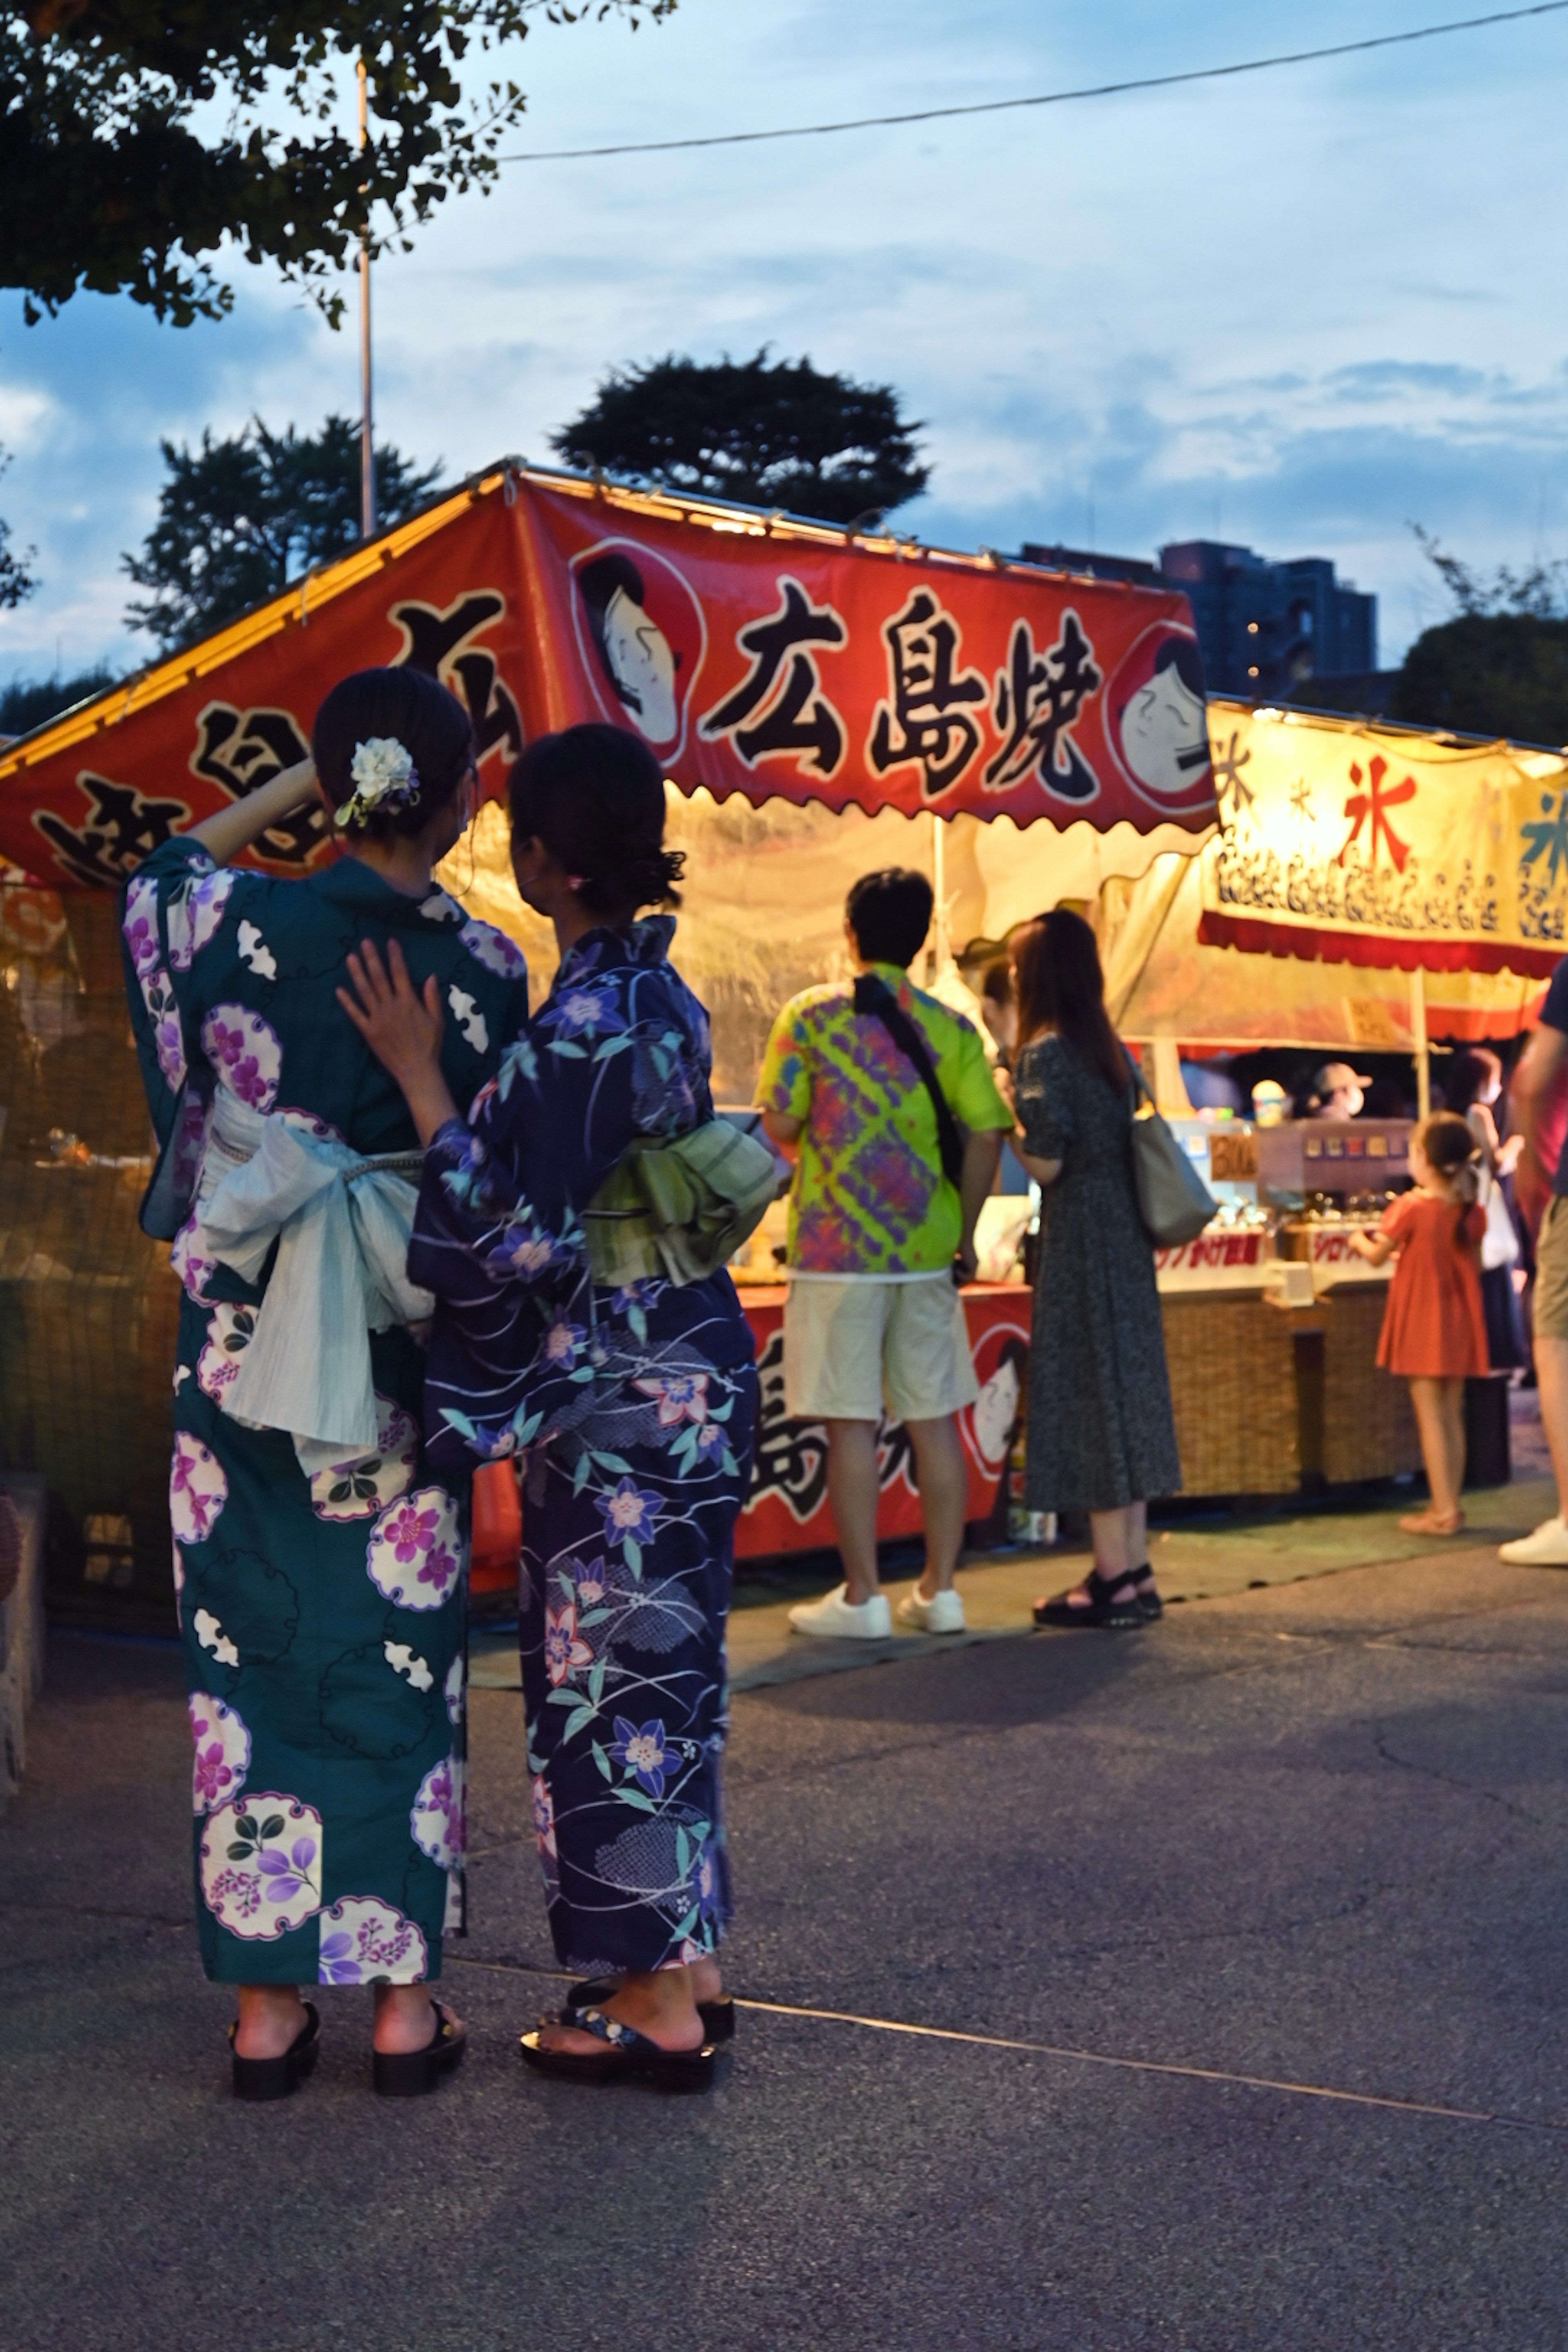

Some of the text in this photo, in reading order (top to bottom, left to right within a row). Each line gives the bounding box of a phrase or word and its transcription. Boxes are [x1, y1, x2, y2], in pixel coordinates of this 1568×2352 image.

[698, 574, 1102, 804] 広島焼
[1338, 755, 1417, 874] 氷
